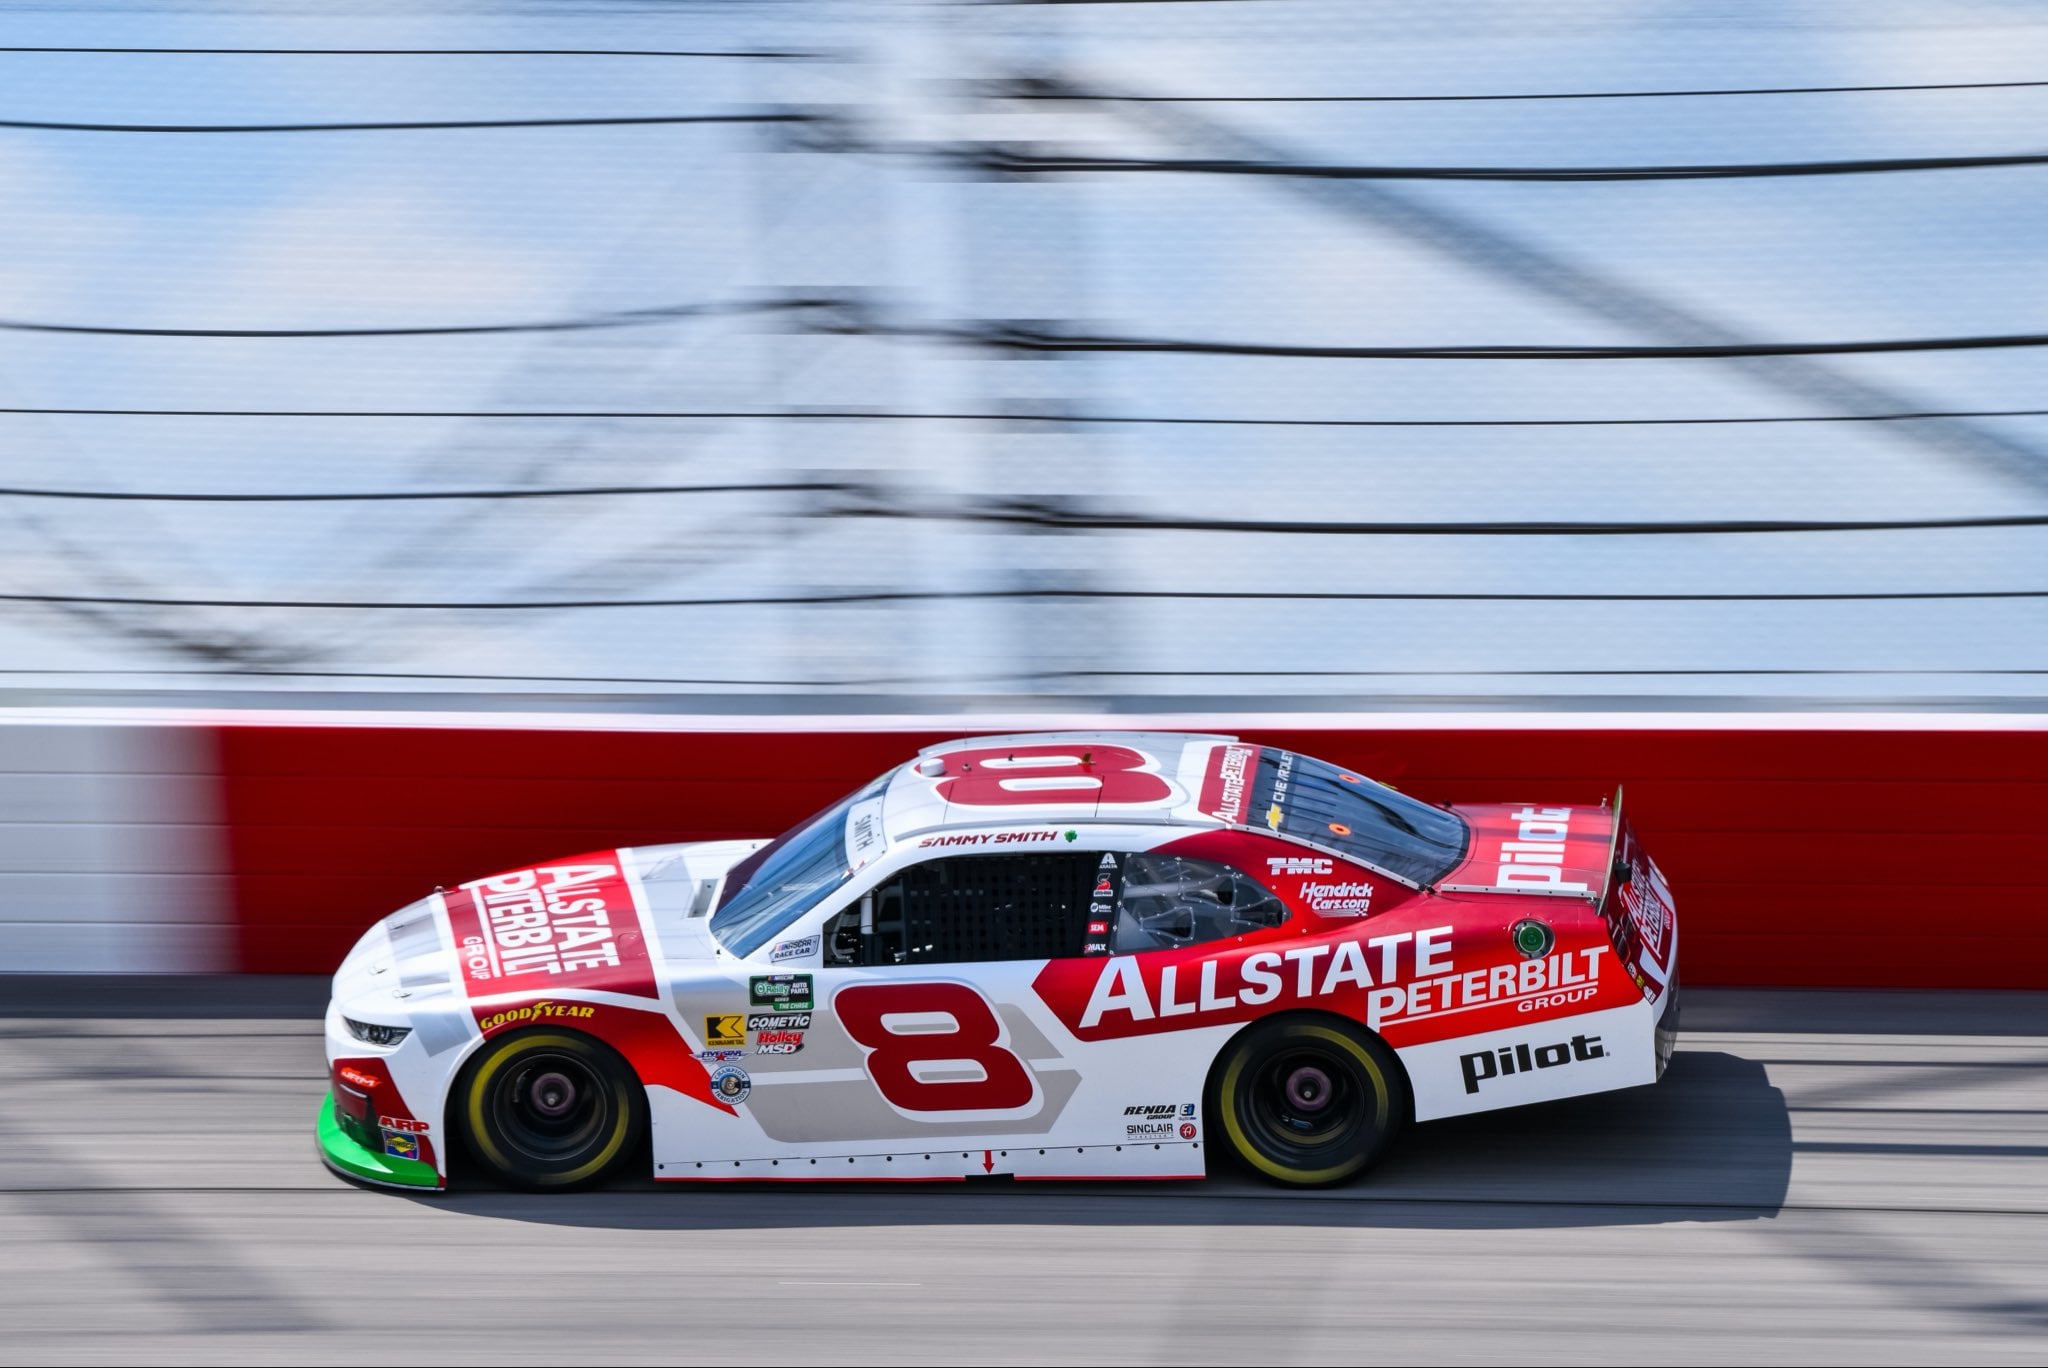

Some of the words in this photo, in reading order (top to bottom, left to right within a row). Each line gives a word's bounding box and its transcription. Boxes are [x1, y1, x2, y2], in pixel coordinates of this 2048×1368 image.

[854, 814, 875, 852] SMITH
[918, 834, 993, 849] SAMMY
[994, 831, 1058, 844] SMITH
[1266, 857, 1333, 876] TMC
[1299, 881, 1374, 904] Hendrick
[1312, 898, 1370, 910] Cars.com
[774, 949, 793, 959] RACE
[795, 947, 810, 955] CAR
[783, 939, 812, 949] NASCAR
[462, 935, 491, 980] GROUP
[1078, 925, 1454, 1029] ALLSTATE
[1366, 945, 1610, 1033] PETERBILT
[1517, 987, 1599, 1013] GROUP
[480, 1001, 595, 1029] GOODYEAR
[748, 1016, 810, 1028] COMETIC
[758, 1031, 802, 1046] Holley
[834, 982, 1034, 1112] 8
[758, 1044, 797, 1054] MSD
[714, 1067, 746, 1080] CHAMPION
[714, 1090, 748, 1103] IRRIGATION
[1123, 1104, 1177, 1115] RENDA
[379, 1115, 430, 1133] ARP
[1126, 1123, 1174, 1134] SINCLAIR
